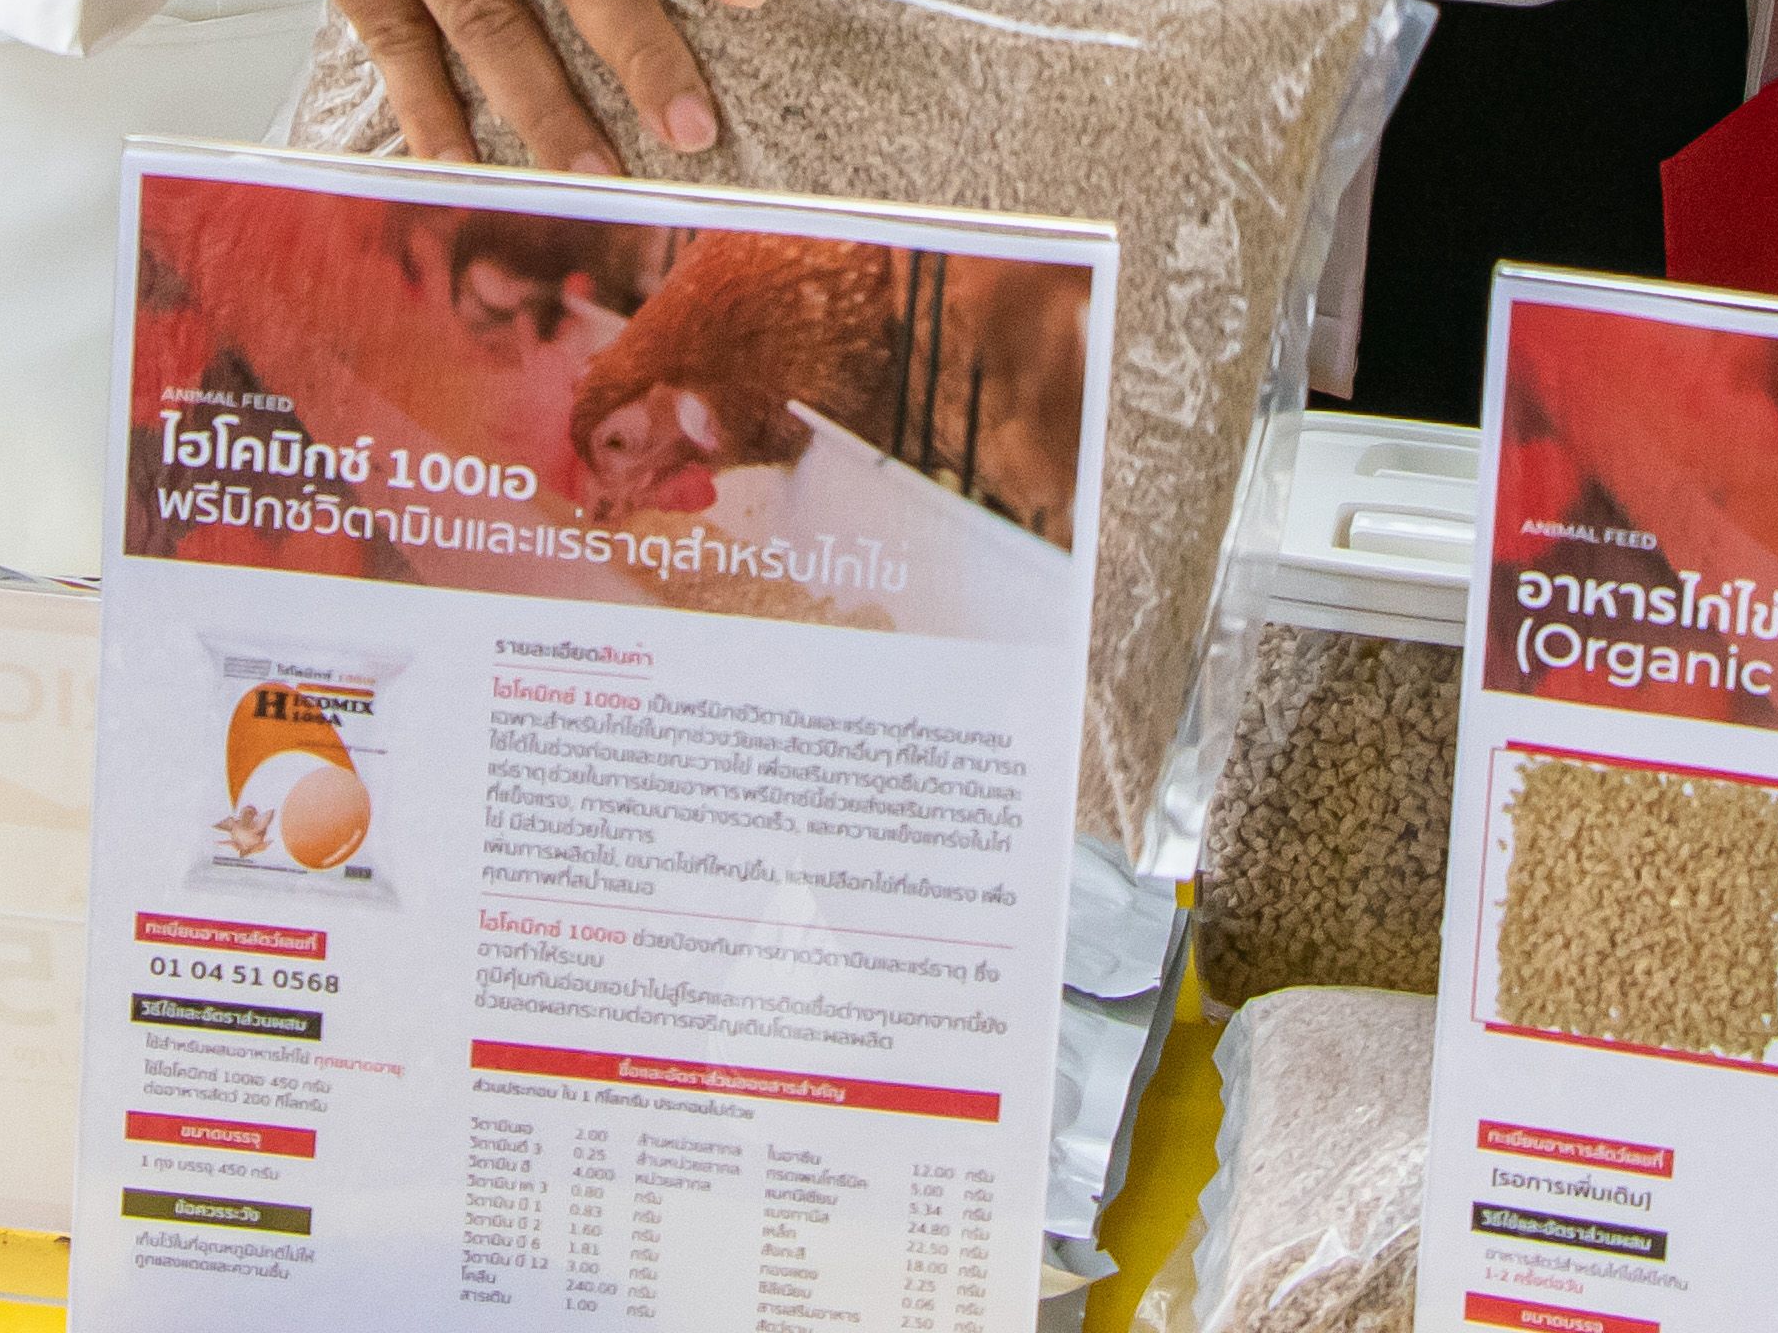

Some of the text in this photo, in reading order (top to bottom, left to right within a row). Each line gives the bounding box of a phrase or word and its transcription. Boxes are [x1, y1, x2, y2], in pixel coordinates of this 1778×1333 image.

[241, 393, 294, 412] FEED
[158, 407, 536, 500] ไฮโคมิกซ์ 100เอ
[1603, 527, 1659, 550] FEED
[1516, 618, 1776, 700] (Organic
[150, 956, 338, 993] 01 04 51 0568
